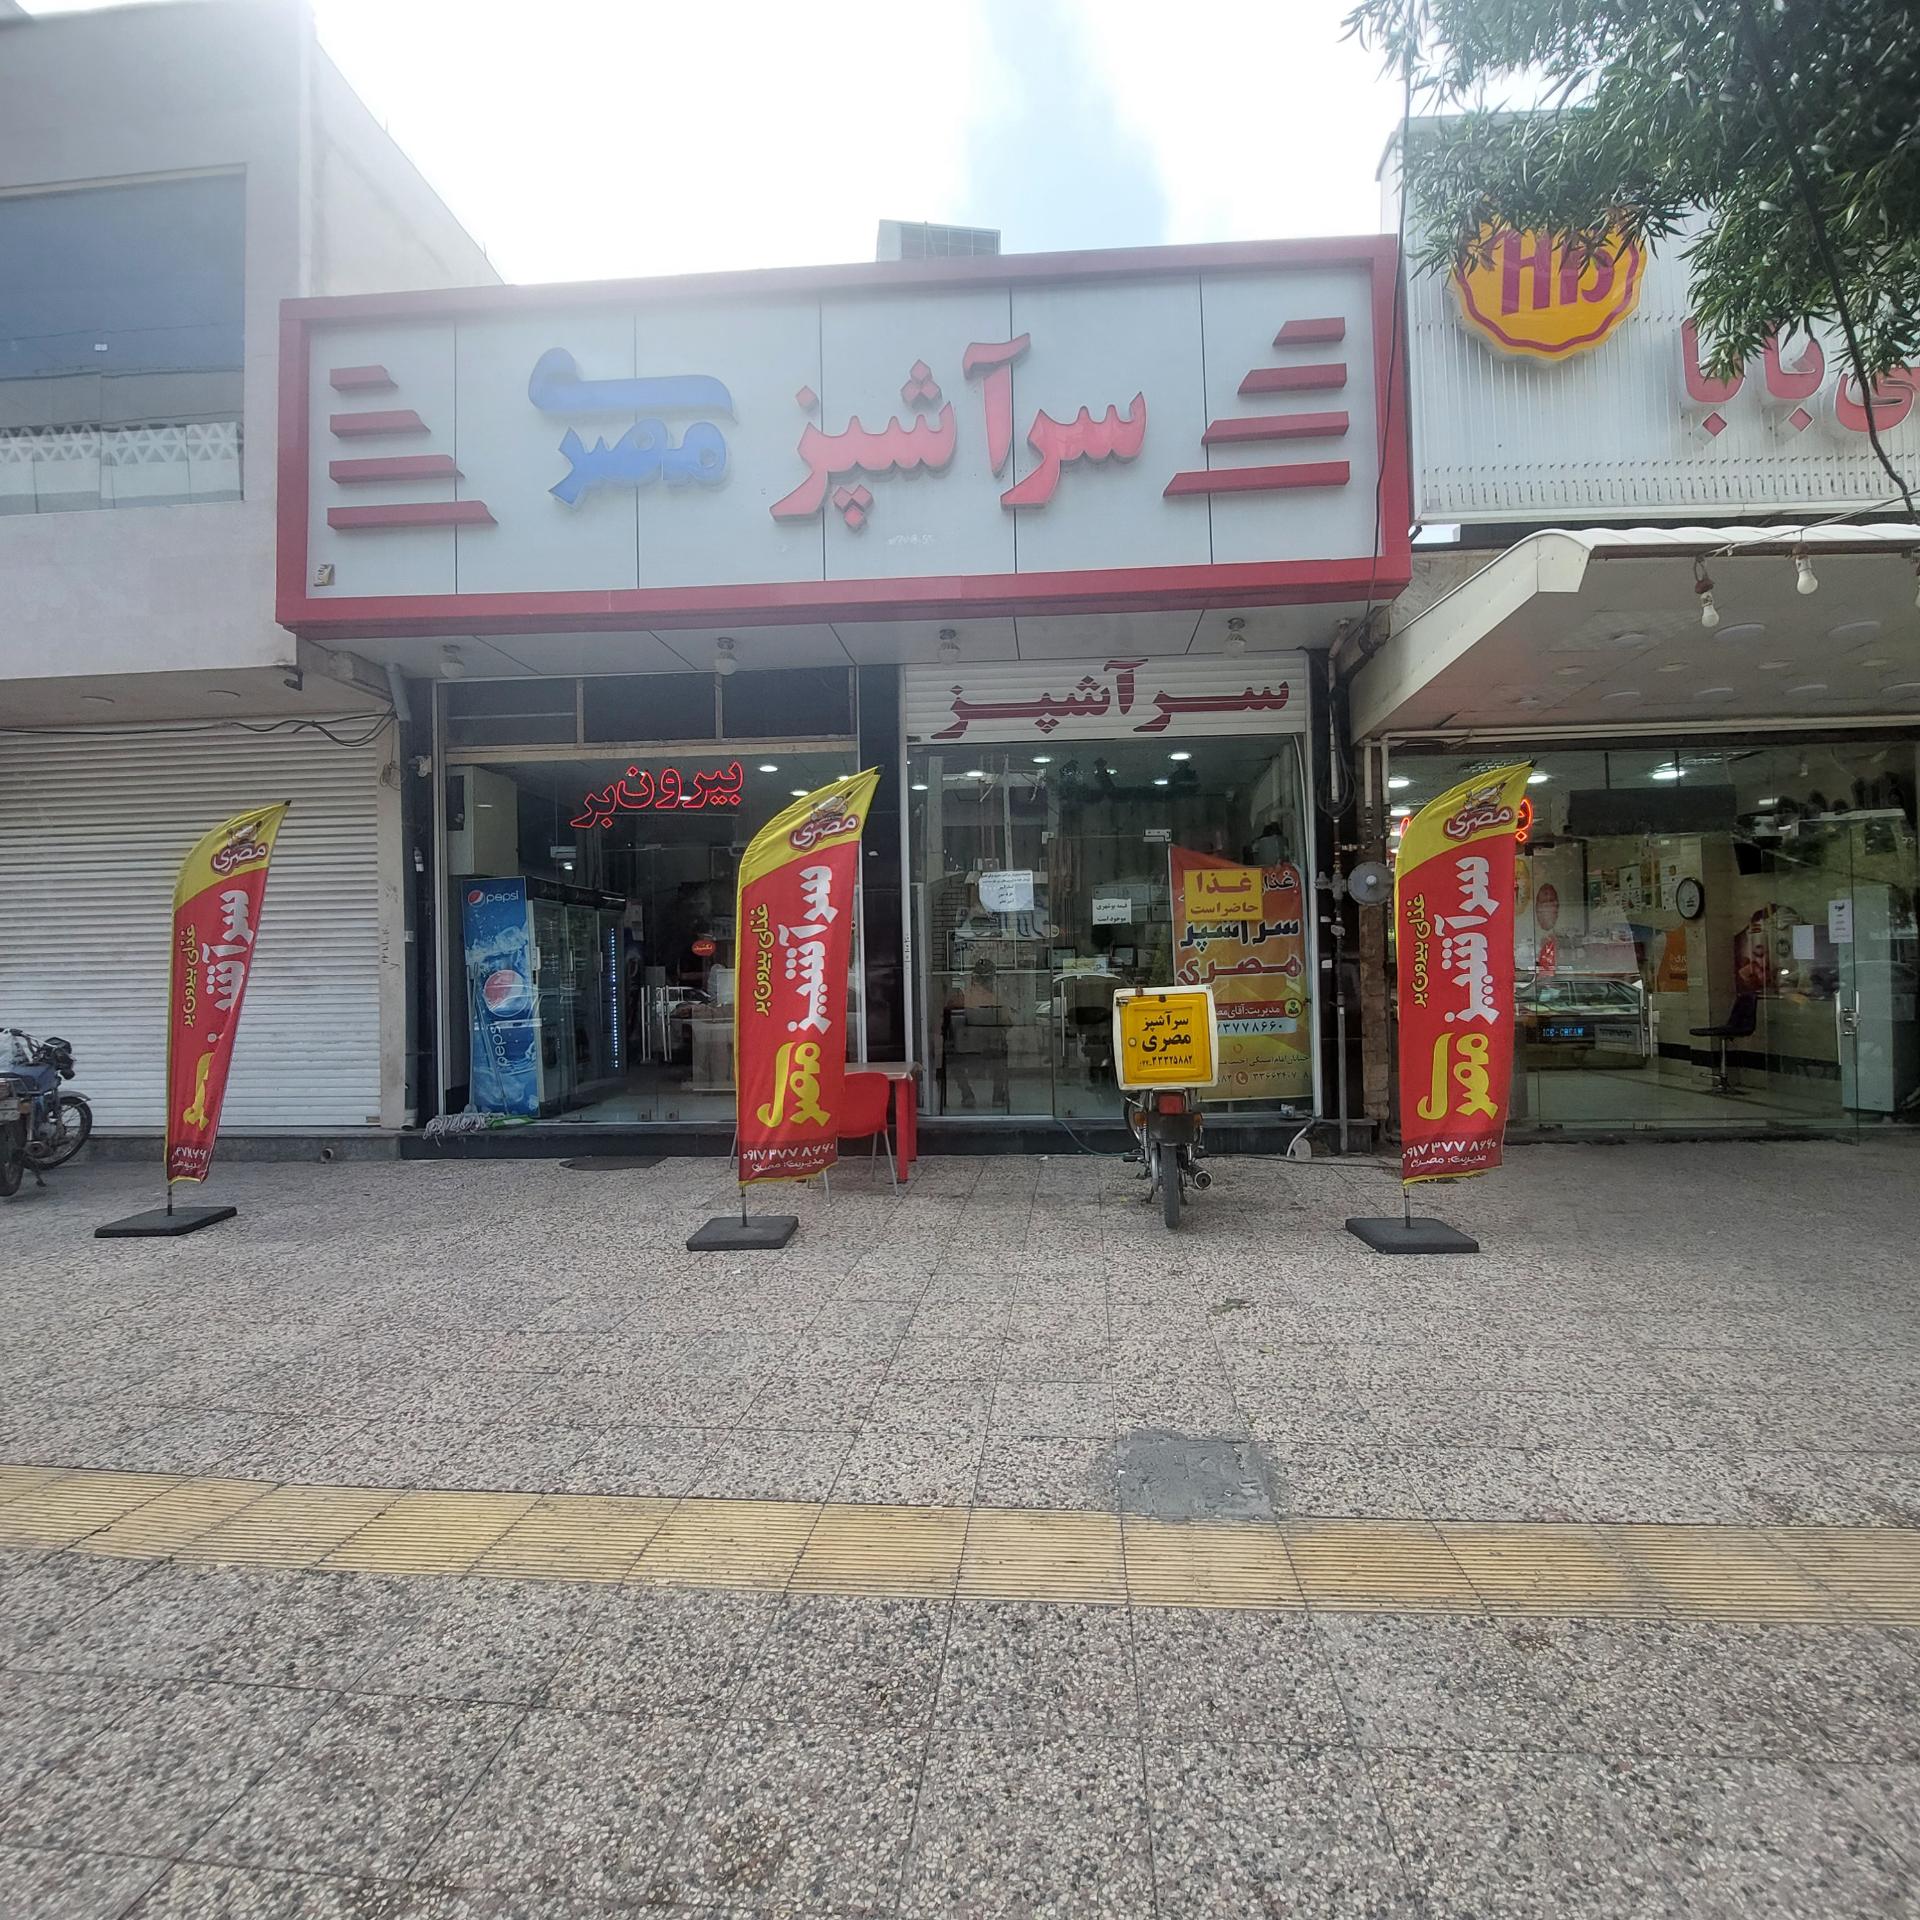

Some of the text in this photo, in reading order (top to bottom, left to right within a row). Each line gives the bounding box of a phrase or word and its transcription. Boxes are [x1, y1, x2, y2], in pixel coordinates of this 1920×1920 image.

[570, 761, 744, 829] بیرون بر
[790, 816, 859, 849] مصری
[1446, 806, 1512, 840] مصری
[212, 843, 268, 874] مصری
[486, 890, 519, 904] pepsi
[1195, 870, 1252, 894] غذا
[1190, 901, 1259, 917] حاضر است
[778, 866, 839, 1035] سرآشپز
[1406, 893, 1432, 1010] غذای بیرون بر
[1434, 856, 1500, 1026] سرآشپز
[181, 924, 199, 1028] غذای بیرون بر
[751, 903, 775, 1017] غذای بیرون بر
[1177, 955, 1302, 985] مصری
[1141, 1033, 1192, 1053] مصری
